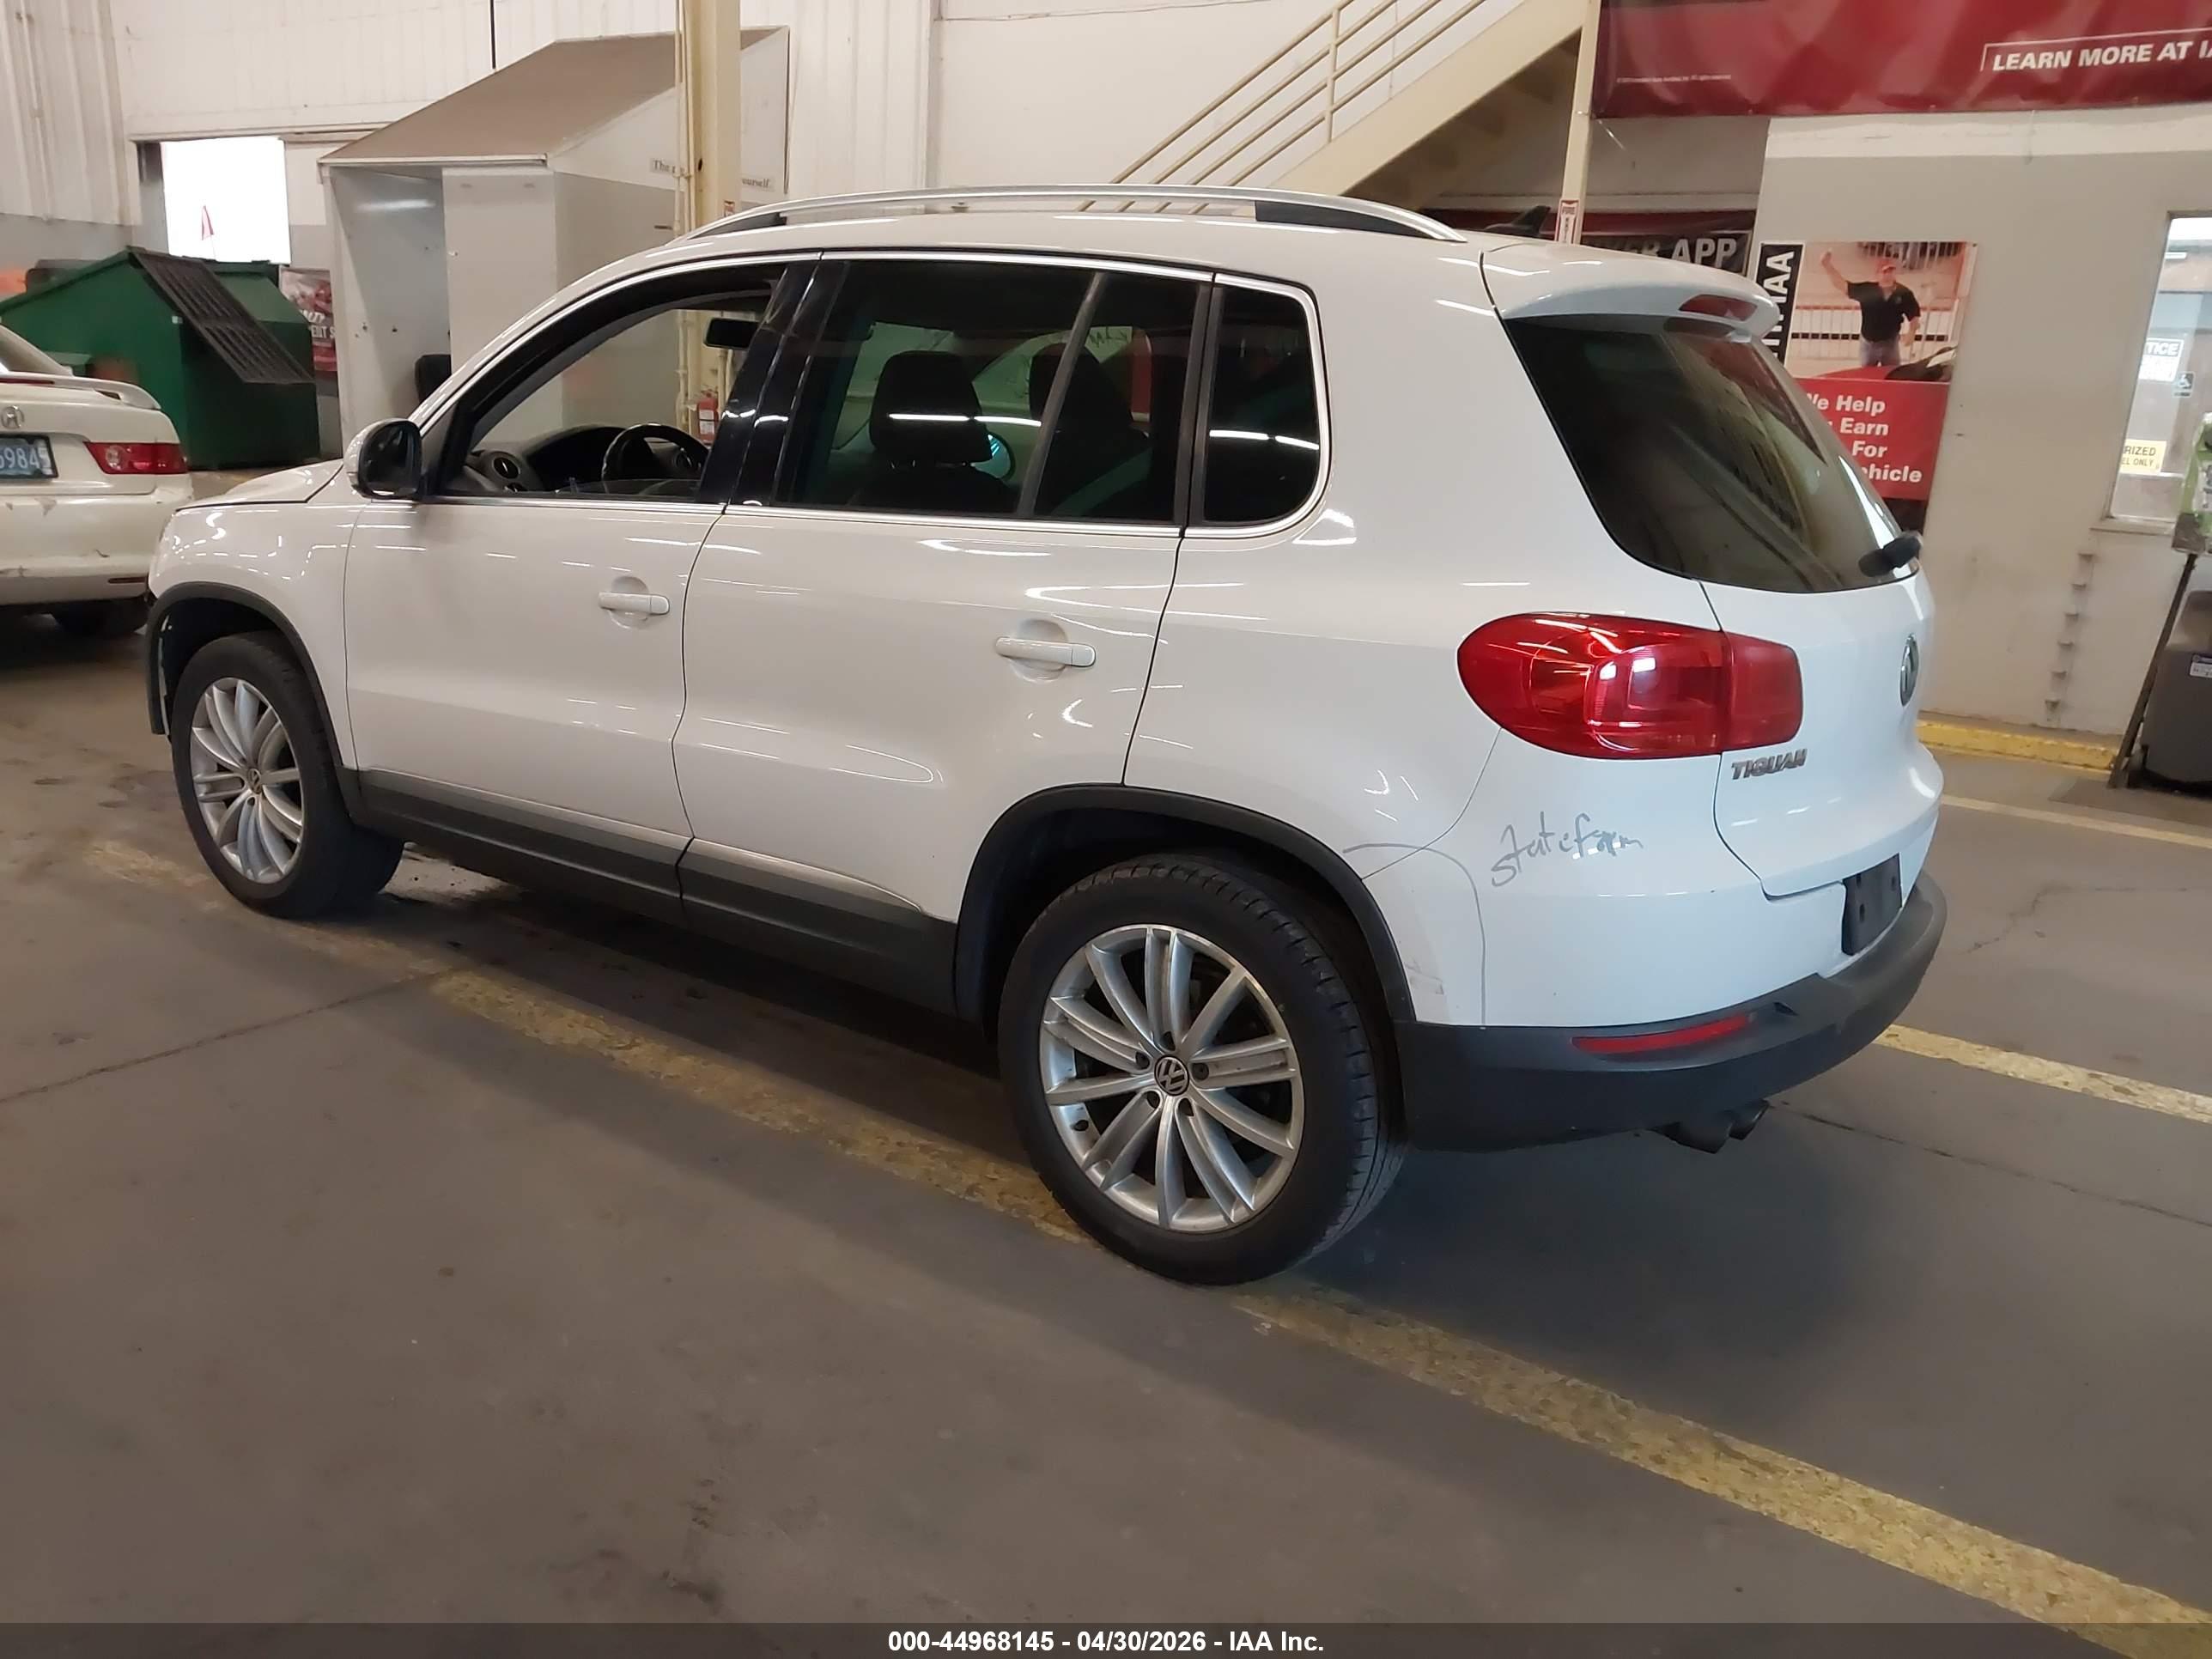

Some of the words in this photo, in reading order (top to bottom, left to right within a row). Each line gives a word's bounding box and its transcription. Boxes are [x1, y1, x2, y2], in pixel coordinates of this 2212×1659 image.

[1992, 50, 2072, 71] LEARN
[2078, 44, 2154, 67] MORE
[2157, 41, 2192, 61] AT
[1671, 238, 1737, 269] APP
[1836, 395, 1886, 416] Help
[1839, 417, 1889, 436] Earn
[1852, 440, 1887, 458] For
[2133, 459, 2154, 467] ONLY
[1862, 464, 1923, 483] hicle
[1731, 749, 1808, 780] TIQUAN
